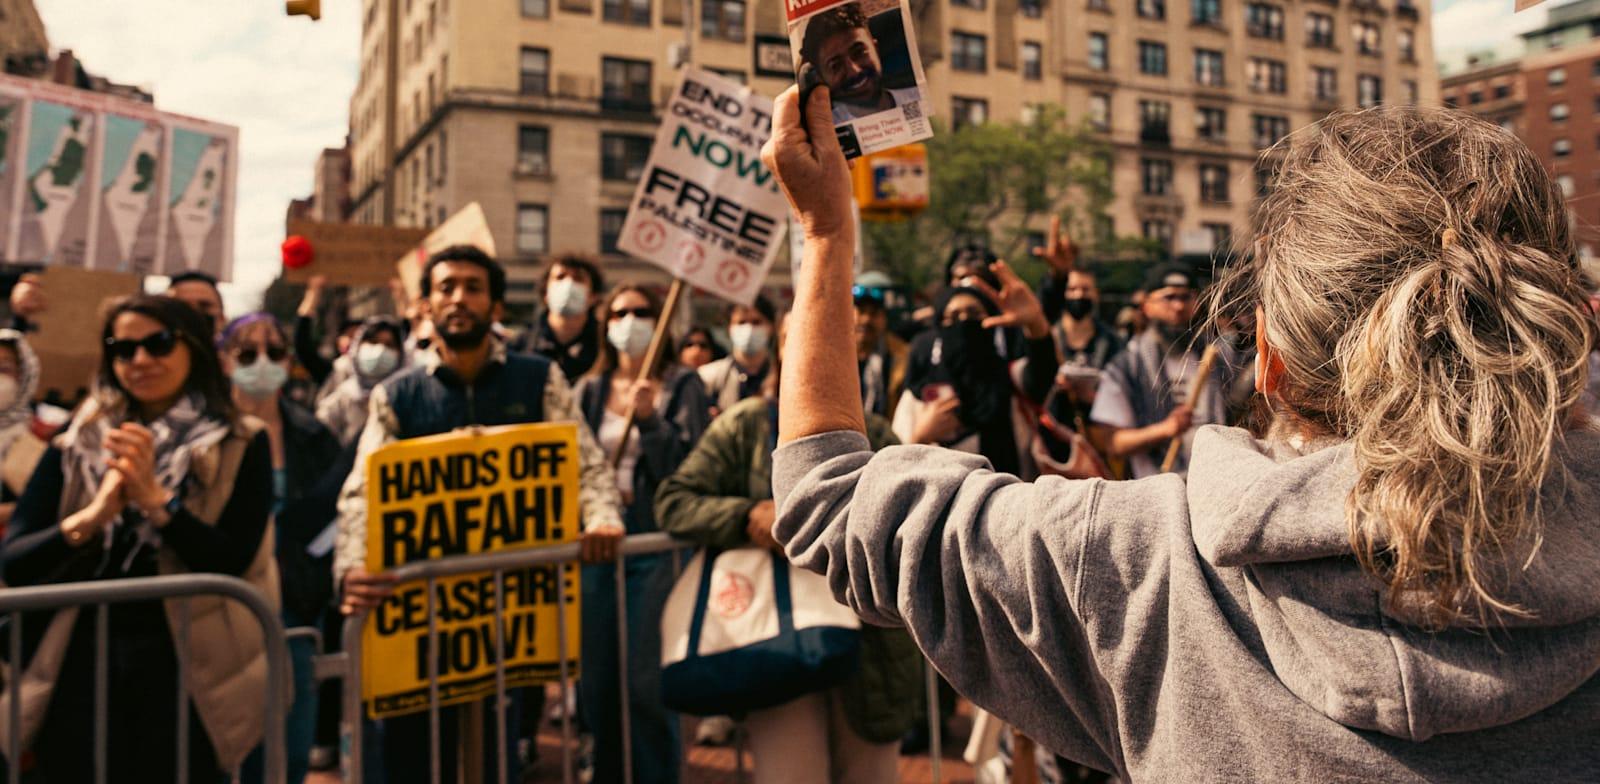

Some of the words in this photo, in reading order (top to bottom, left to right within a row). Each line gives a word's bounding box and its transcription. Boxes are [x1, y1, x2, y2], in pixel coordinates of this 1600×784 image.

[681, 79, 742, 118] END
[645, 165, 775, 247] FREE
[380, 449, 500, 503] HANDS
[509, 441, 568, 481] OFF
[382, 484, 564, 569] RAFAH!
[416, 612, 537, 681] NOW!
